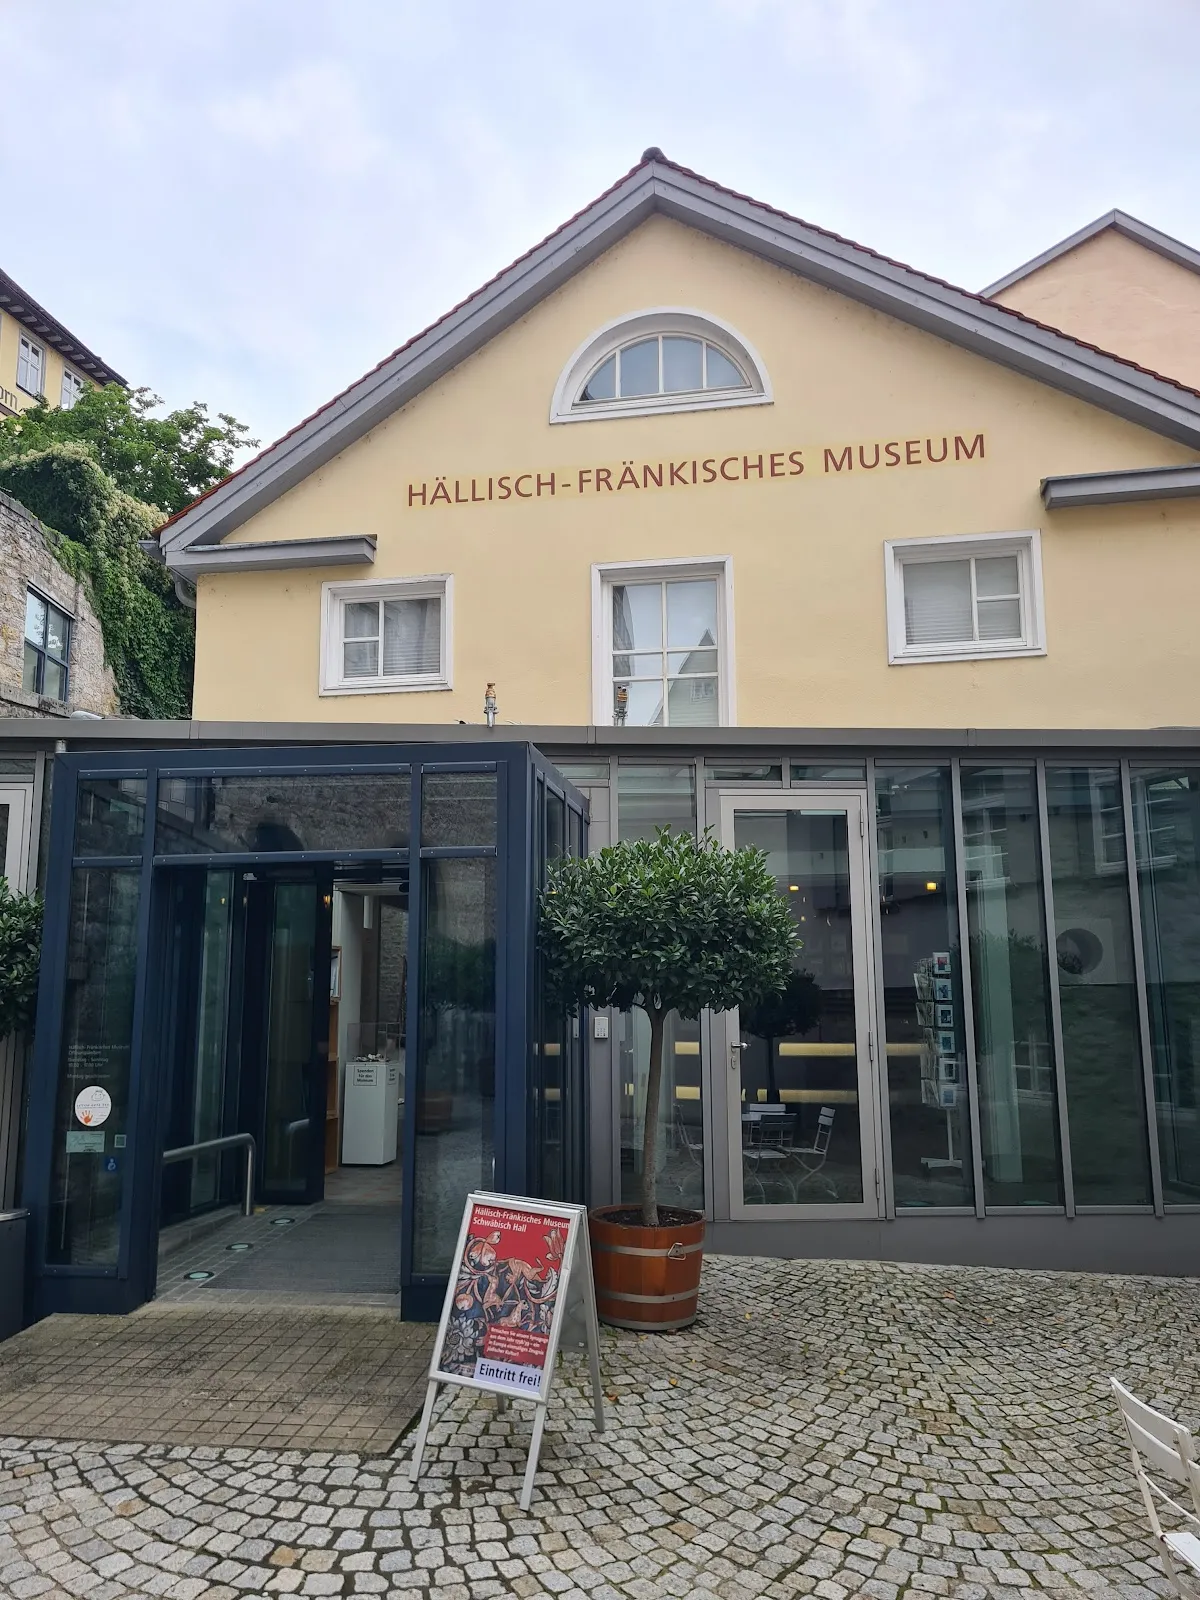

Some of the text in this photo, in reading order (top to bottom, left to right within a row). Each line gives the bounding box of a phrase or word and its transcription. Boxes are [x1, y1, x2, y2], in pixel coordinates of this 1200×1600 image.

[408, 434, 985, 507] HÄLLISCH-FRÄNKISCHES MUSEUM
[472, 1216, 527, 1233] Schwäbisch Hall
[474, 1206, 542, 1225] Hällisch-Fränkisches
[479, 1363, 541, 1387] Eintritt frei!
